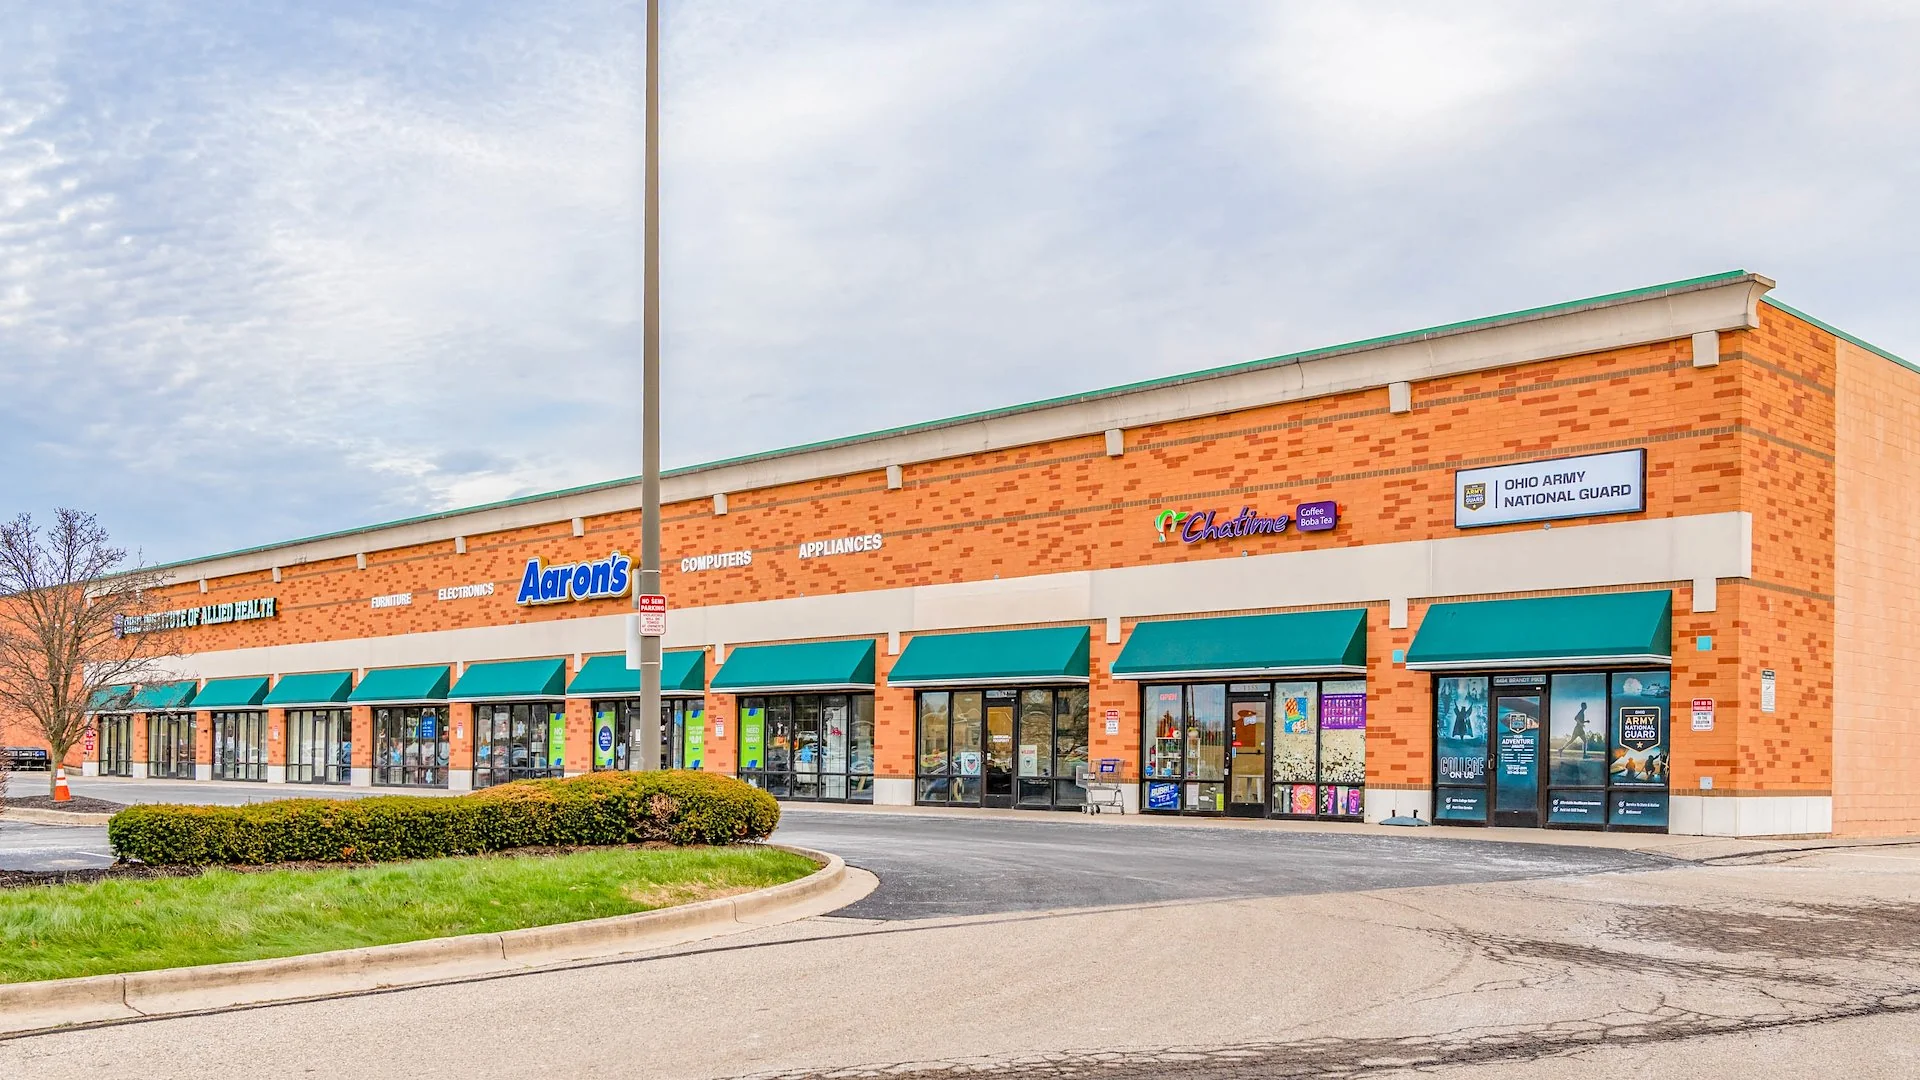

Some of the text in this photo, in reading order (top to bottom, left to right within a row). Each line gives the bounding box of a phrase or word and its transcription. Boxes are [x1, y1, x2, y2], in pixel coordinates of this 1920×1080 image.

[1504, 471, 1586, 491] OHIO ARMY
[1504, 484, 1632, 507] NATIONAL GUARD
[1300, 507, 1324, 517] Coffee
[1181, 505, 1289, 544] Chatime
[1300, 516, 1333, 527] Boba Tea
[798, 533, 883, 559] APPLIANCES
[681, 550, 752, 573] COMPUTERS
[516, 551, 632, 606] Aaron's
[371, 593, 412, 608] FURNITURE
[438, 583, 494, 601] ELECTRONICS
[187, 607, 200, 627] OF
[201, 603, 233, 625] ALLIED
[234, 598, 275, 620] HEALTH
[1159, 693, 1177, 701] OPEN
[1625, 716, 1655, 725] ARMY
[1624, 730, 1656, 739] GUARD
[1440, 756, 1484, 776] COLLEGE
[1450, 771, 1475, 779] ON US
[1157, 794, 1171, 802] TEA
